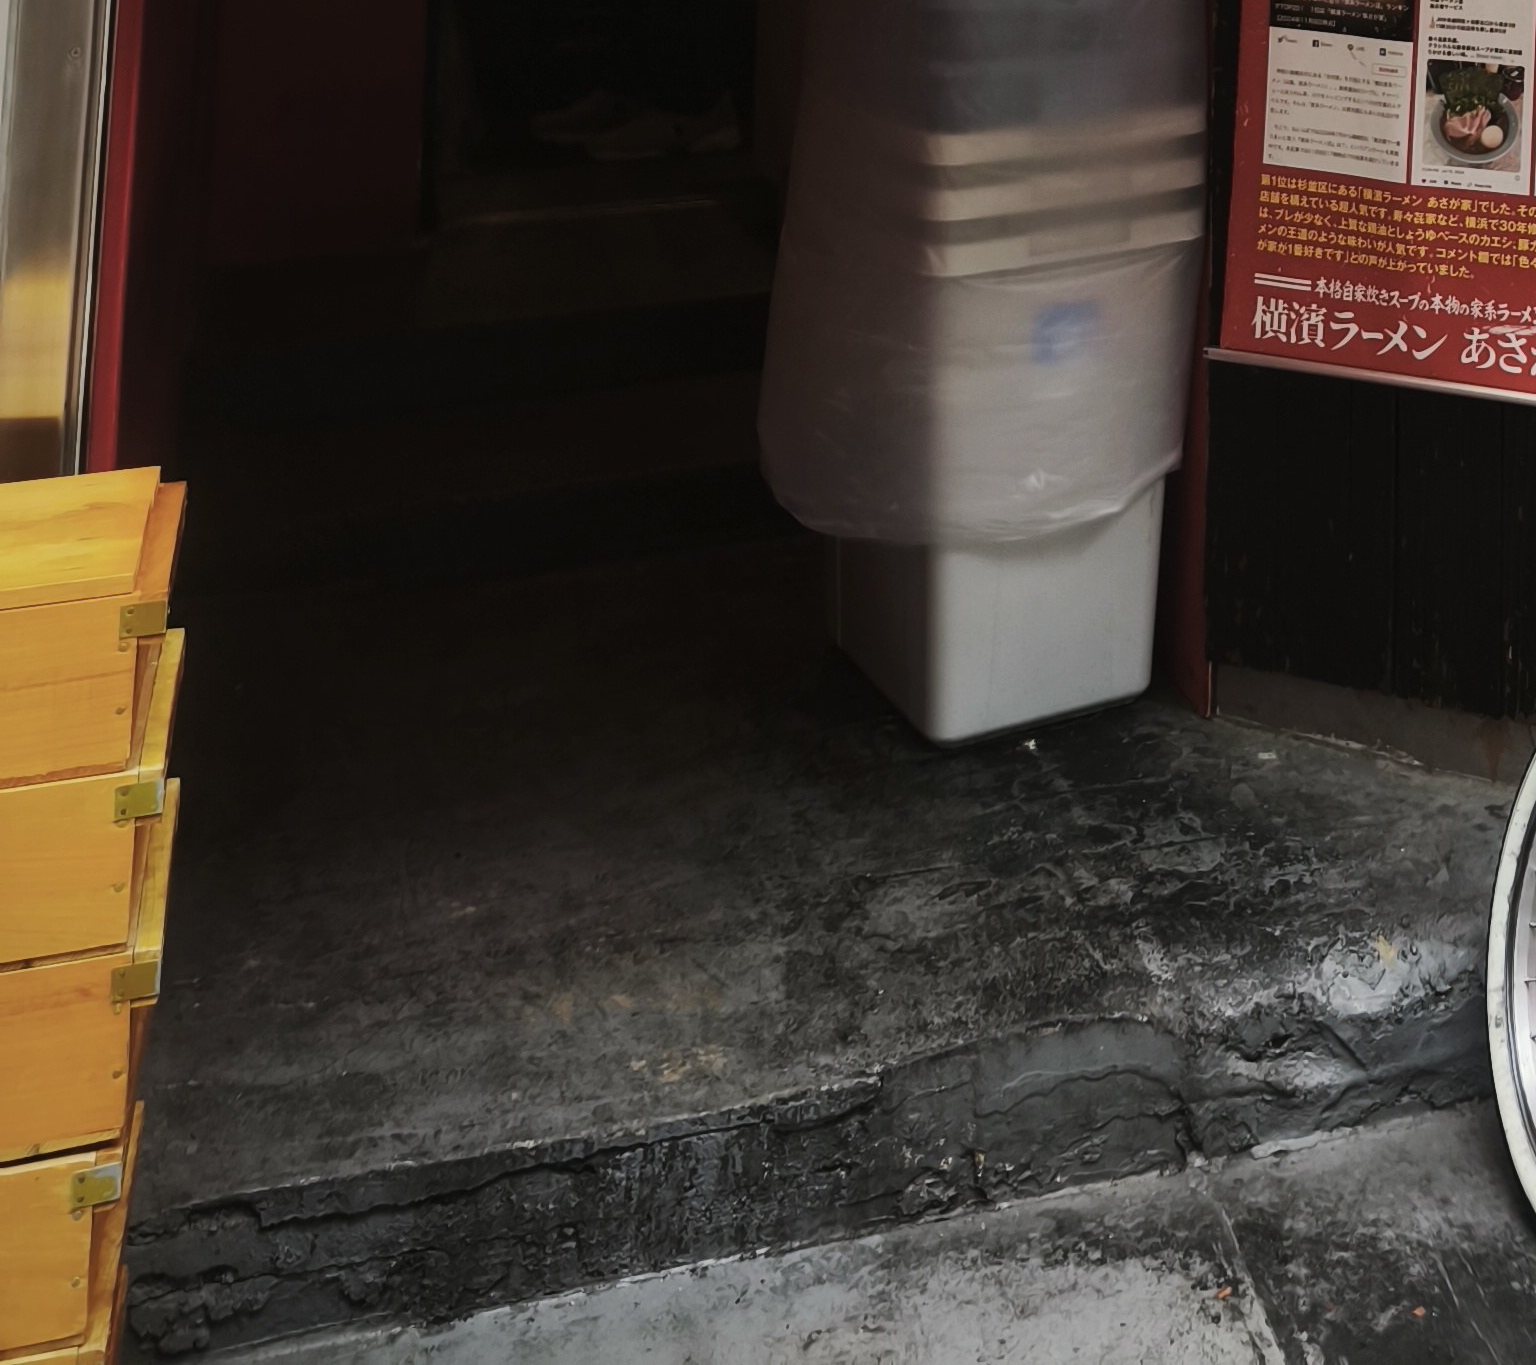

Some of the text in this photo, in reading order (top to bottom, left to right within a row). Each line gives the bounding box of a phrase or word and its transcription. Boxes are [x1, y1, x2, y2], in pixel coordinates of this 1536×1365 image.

[1251, 295, 1448, 360] 横濱ラーメン
